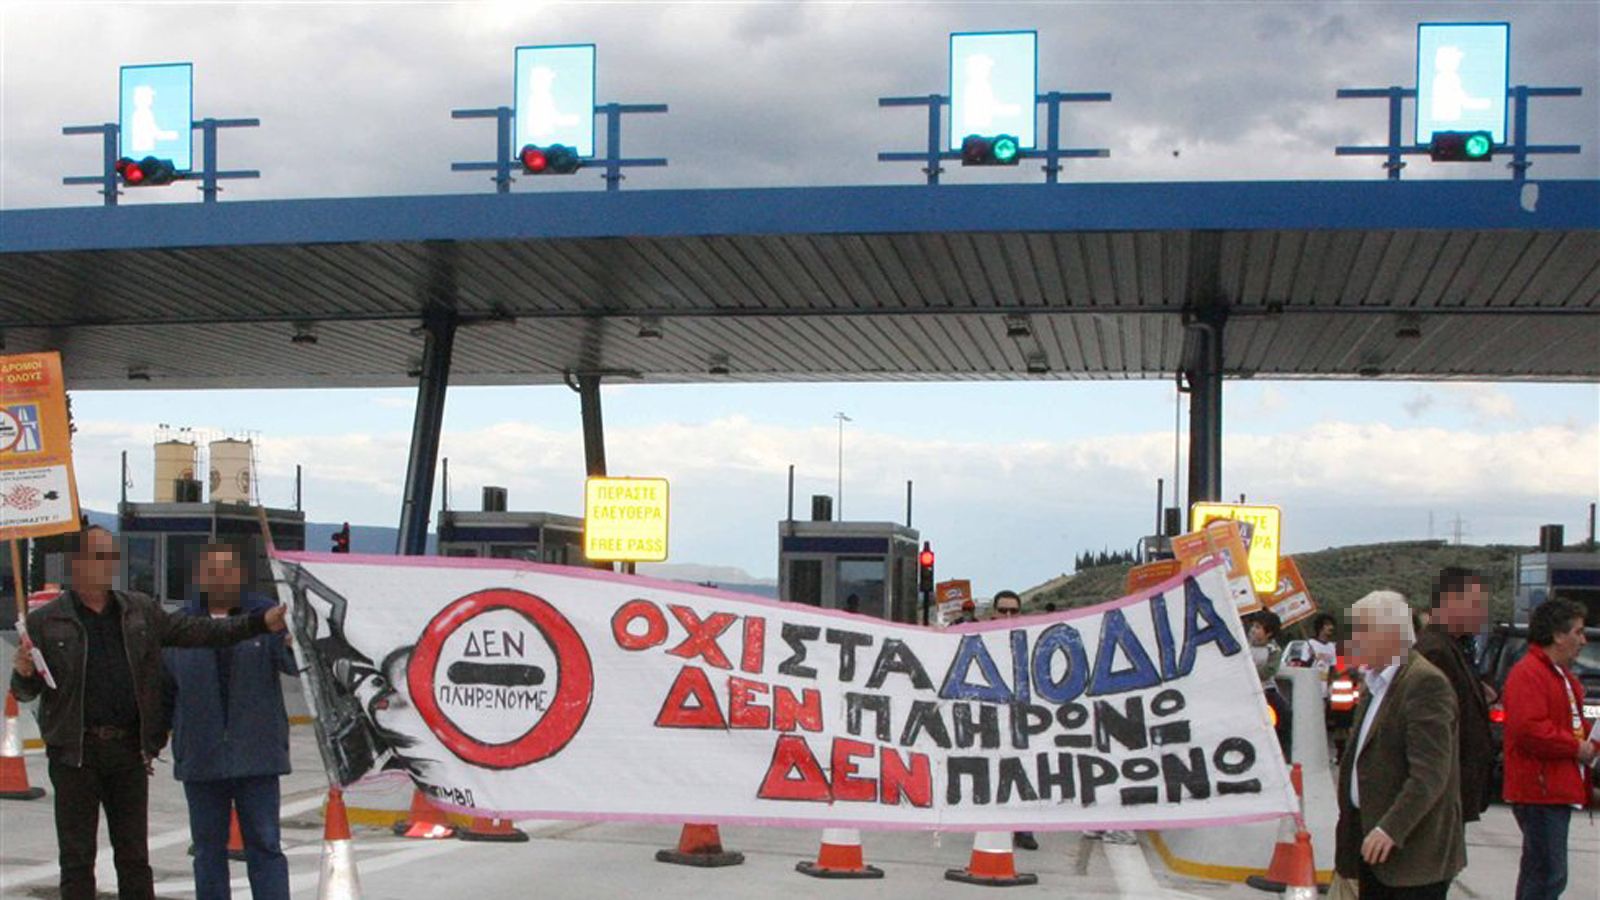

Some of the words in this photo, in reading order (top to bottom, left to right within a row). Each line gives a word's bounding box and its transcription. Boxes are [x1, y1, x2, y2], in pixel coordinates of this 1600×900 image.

[1, 361, 42, 373] ΔΡΟΜΟΙ
[597, 486, 657, 500] ΠΕΡΑΣΤΕ
[593, 506, 662, 519] ΕΛΕΥΘΕΡΑ
[590, 538, 623, 551] FREE
[627, 538, 662, 552] PASS
[462, 630, 525, 658] ΔΕΝ
[610, 599, 766, 674] ΟΧΙ
[778, 621, 936, 692] ΣΤΑ
[938, 575, 1242, 705] ΔΙΟΔΙΑ
[440, 685, 548, 712] ΠΛΗΡΩΝΟΥΜΕ
[653, 665, 823, 733] ΔΕΝ
[846, 688, 1191, 753] ΠΛΗΡΩΝΩ
[757, 734, 934, 809] ΔΕΝ
[946, 737, 1262, 807] ΠΛΗΡΩΝΩ
